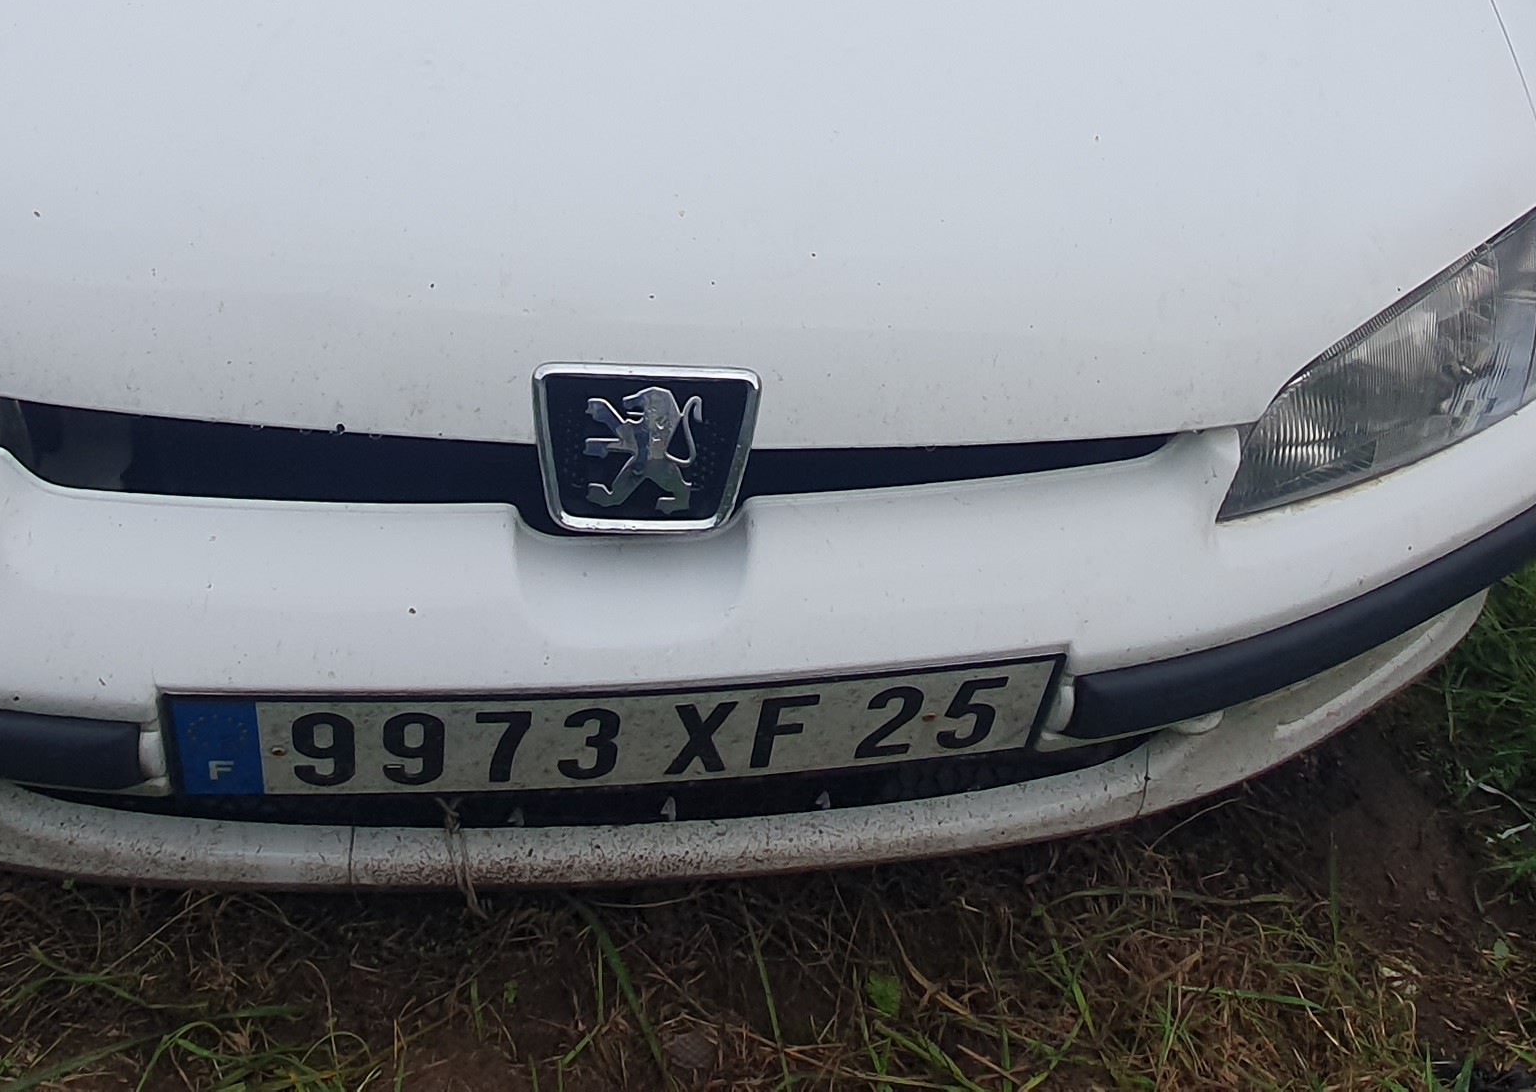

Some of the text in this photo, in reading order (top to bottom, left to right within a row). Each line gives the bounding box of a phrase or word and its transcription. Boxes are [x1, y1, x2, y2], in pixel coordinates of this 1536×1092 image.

[290, 675, 1010, 788] 9973 XF 25
[208, 760, 235, 781] F
